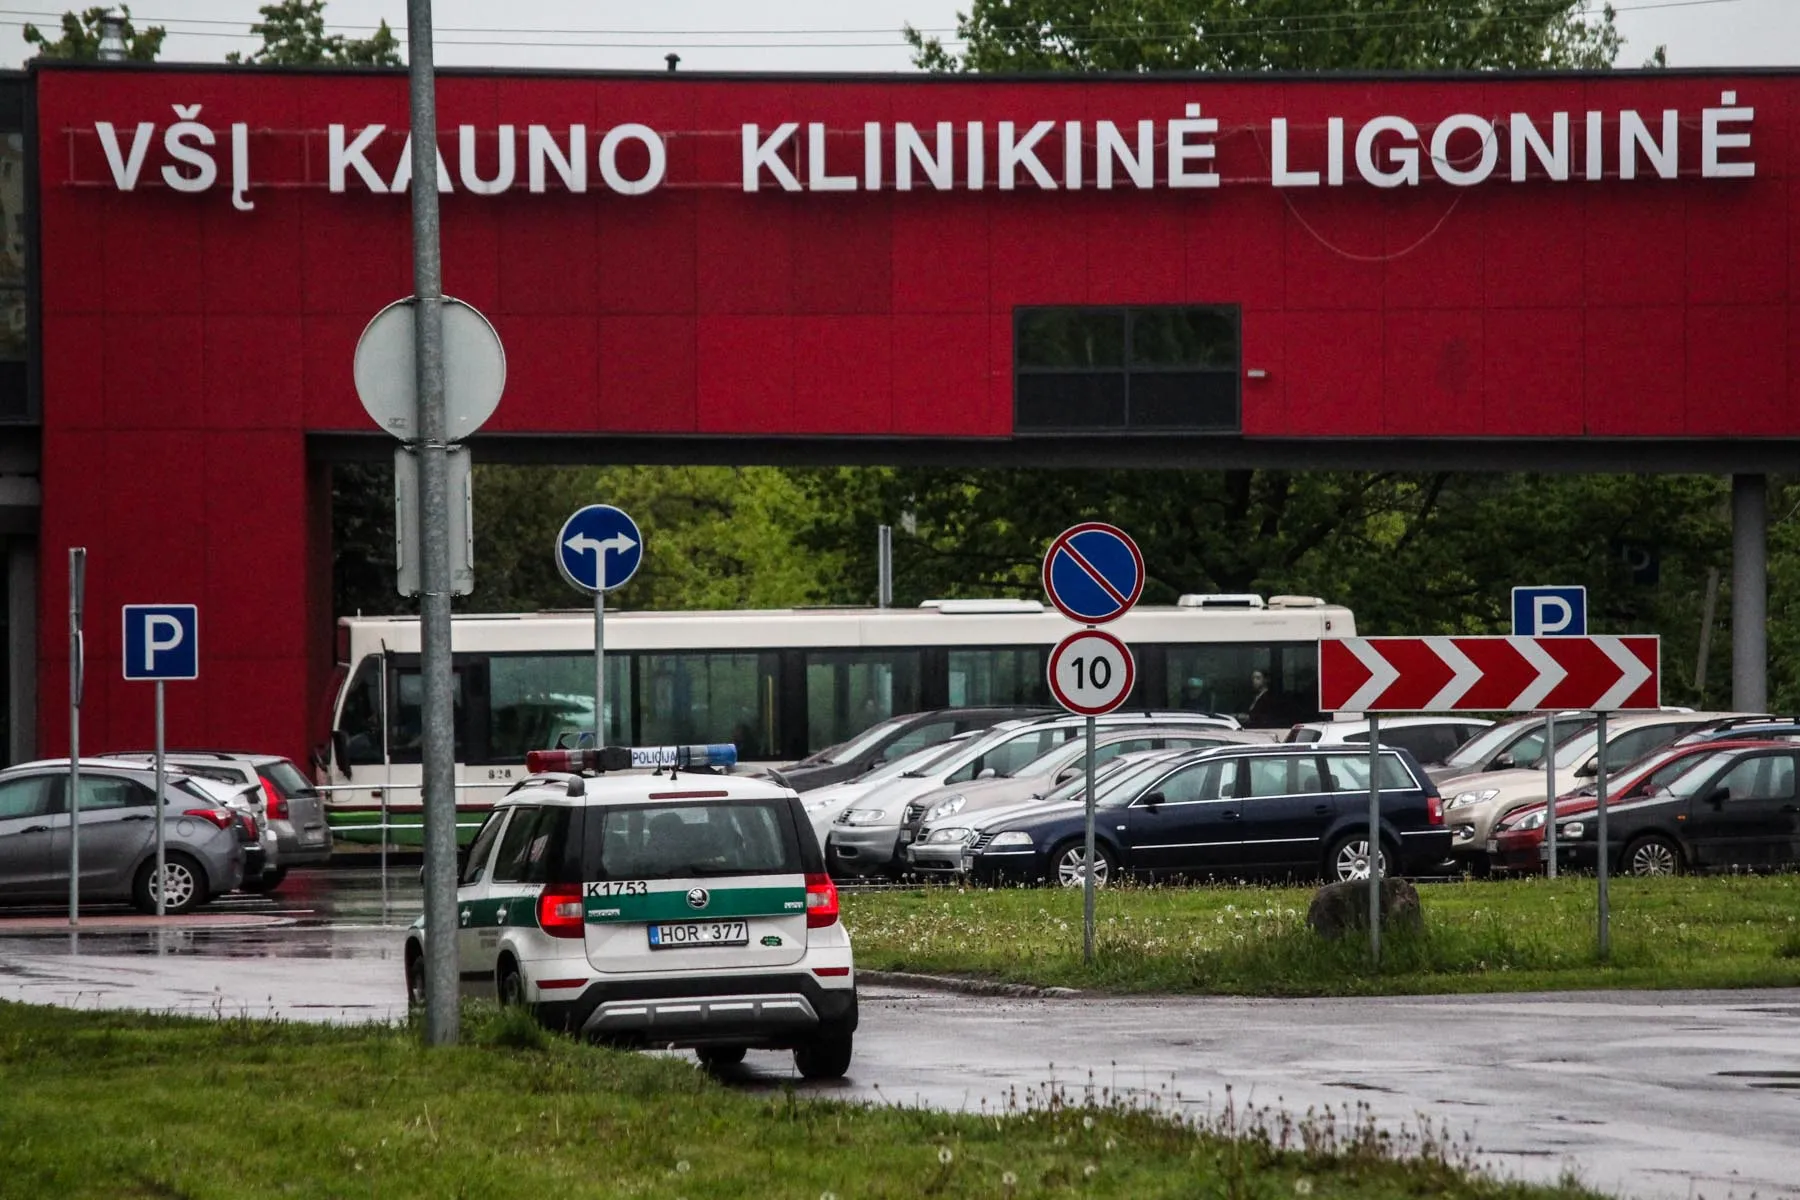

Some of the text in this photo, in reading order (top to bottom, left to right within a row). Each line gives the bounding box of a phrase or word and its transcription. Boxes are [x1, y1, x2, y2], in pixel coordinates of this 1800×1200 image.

[95, 103, 255, 210] VŠĮ
[741, 102, 1220, 192] KLINIKINĖ
[1271, 90, 1756, 188] LIGONINĖ
[1533, 595, 1572, 635] P
[145, 614, 184, 671] P
[1071, 655, 1112, 690] 10
[632, 751, 678, 764] POLICIJA
[587, 881, 648, 898] K1753
[660, 923, 744, 942] HOR 377
